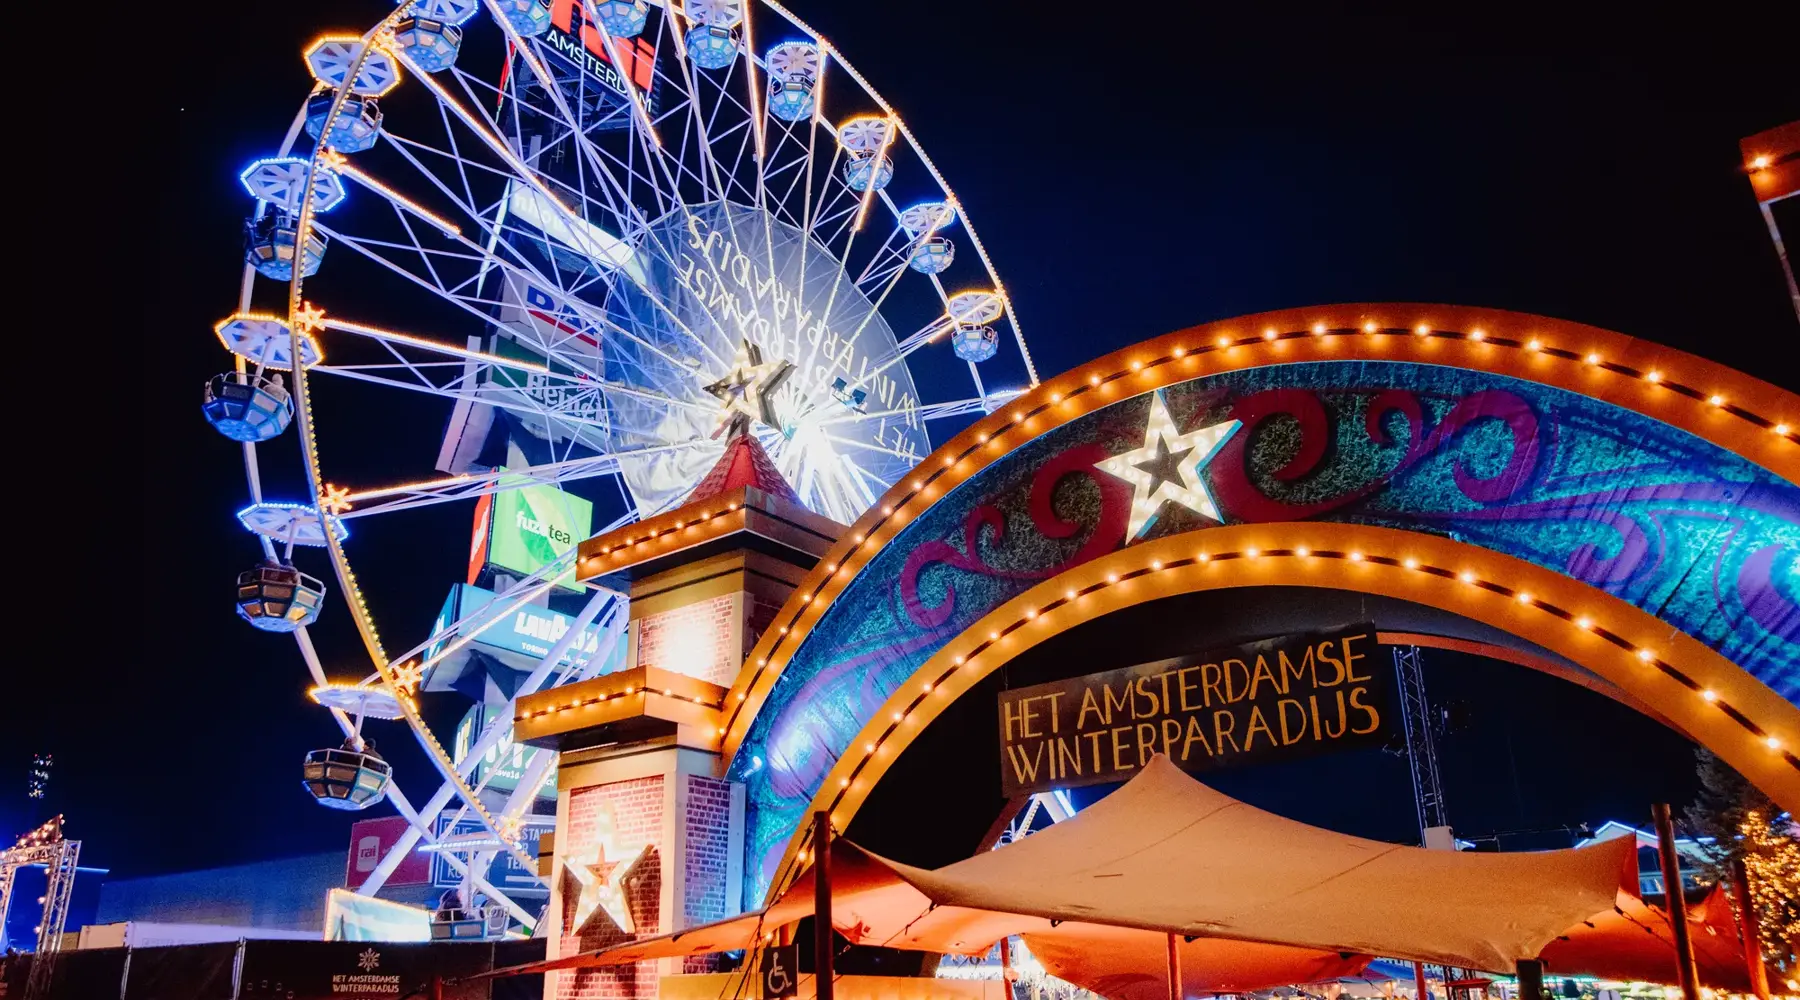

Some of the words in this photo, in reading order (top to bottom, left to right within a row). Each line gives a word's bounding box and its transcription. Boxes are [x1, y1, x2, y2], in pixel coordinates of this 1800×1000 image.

[546, 29, 652, 113] AMSTERDM
[514, 611, 599, 653] LAVAA
[1005, 692, 1066, 741] HET
[1077, 634, 1372, 731] AMSTERDAMSE
[1006, 687, 1380, 784] WINTERPARADIJS
[333, 983, 400, 993] WINTERPARADIJS
[348, 975, 400, 983] AMSTERDAMSE
